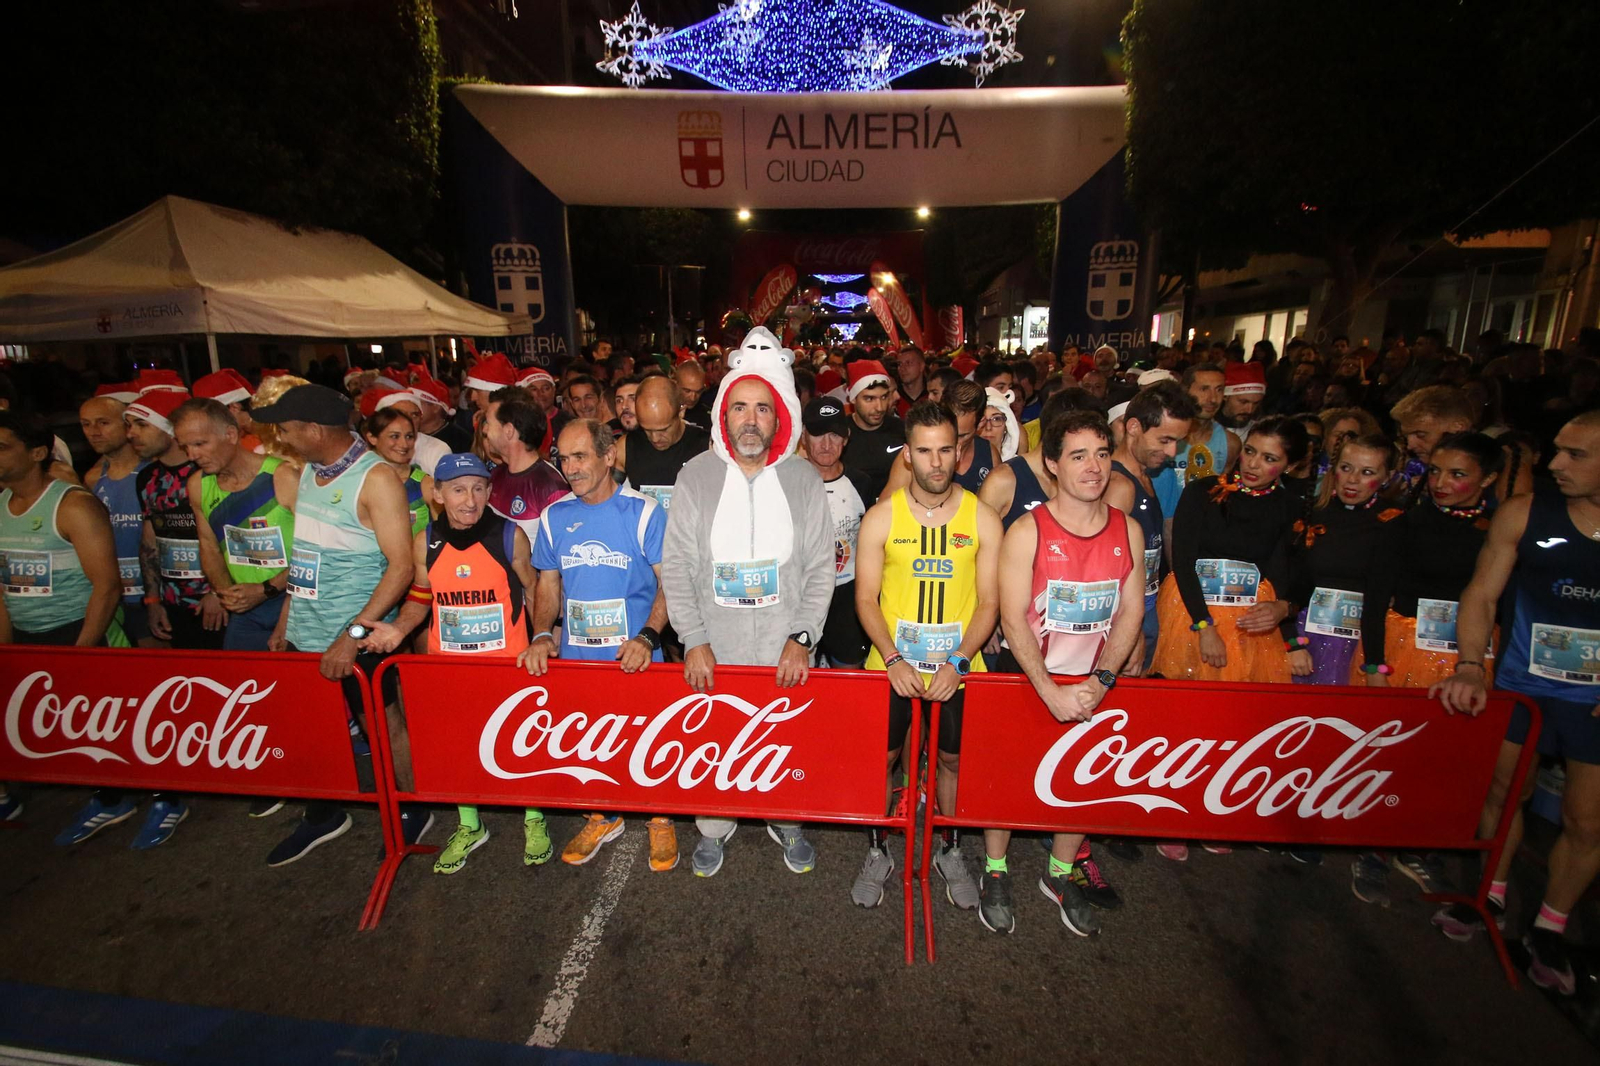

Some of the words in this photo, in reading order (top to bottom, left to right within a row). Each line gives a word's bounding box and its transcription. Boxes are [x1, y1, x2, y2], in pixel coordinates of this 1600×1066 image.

[766, 105, 962, 150] ALMERÍA
[766, 160, 865, 182] CIUDAD
[123, 302, 184, 319] ALMERÍA
[484, 333, 568, 353] ALMERÍA
[1063, 329, 1146, 349] ALMERÍA
[247, 540, 275, 551] 772
[172, 551, 197, 562] 539
[9, 563, 47, 576] 1139
[289, 564, 314, 581] 2578
[912, 558, 953, 573] OTIS
[743, 570, 769, 587] 591
[1220, 572, 1257, 585] 1375
[436, 589, 497, 605] ALMERIA
[1079, 595, 1113, 612] 1970
[461, 620, 500, 636] 2450
[586, 613, 622, 627] 1864
[926, 638, 954, 651] 329
[5, 671, 277, 770] Coca-Cola
[479, 685, 814, 792] Coca-Cola
[1034, 708, 1429, 820] Coca-Cola
